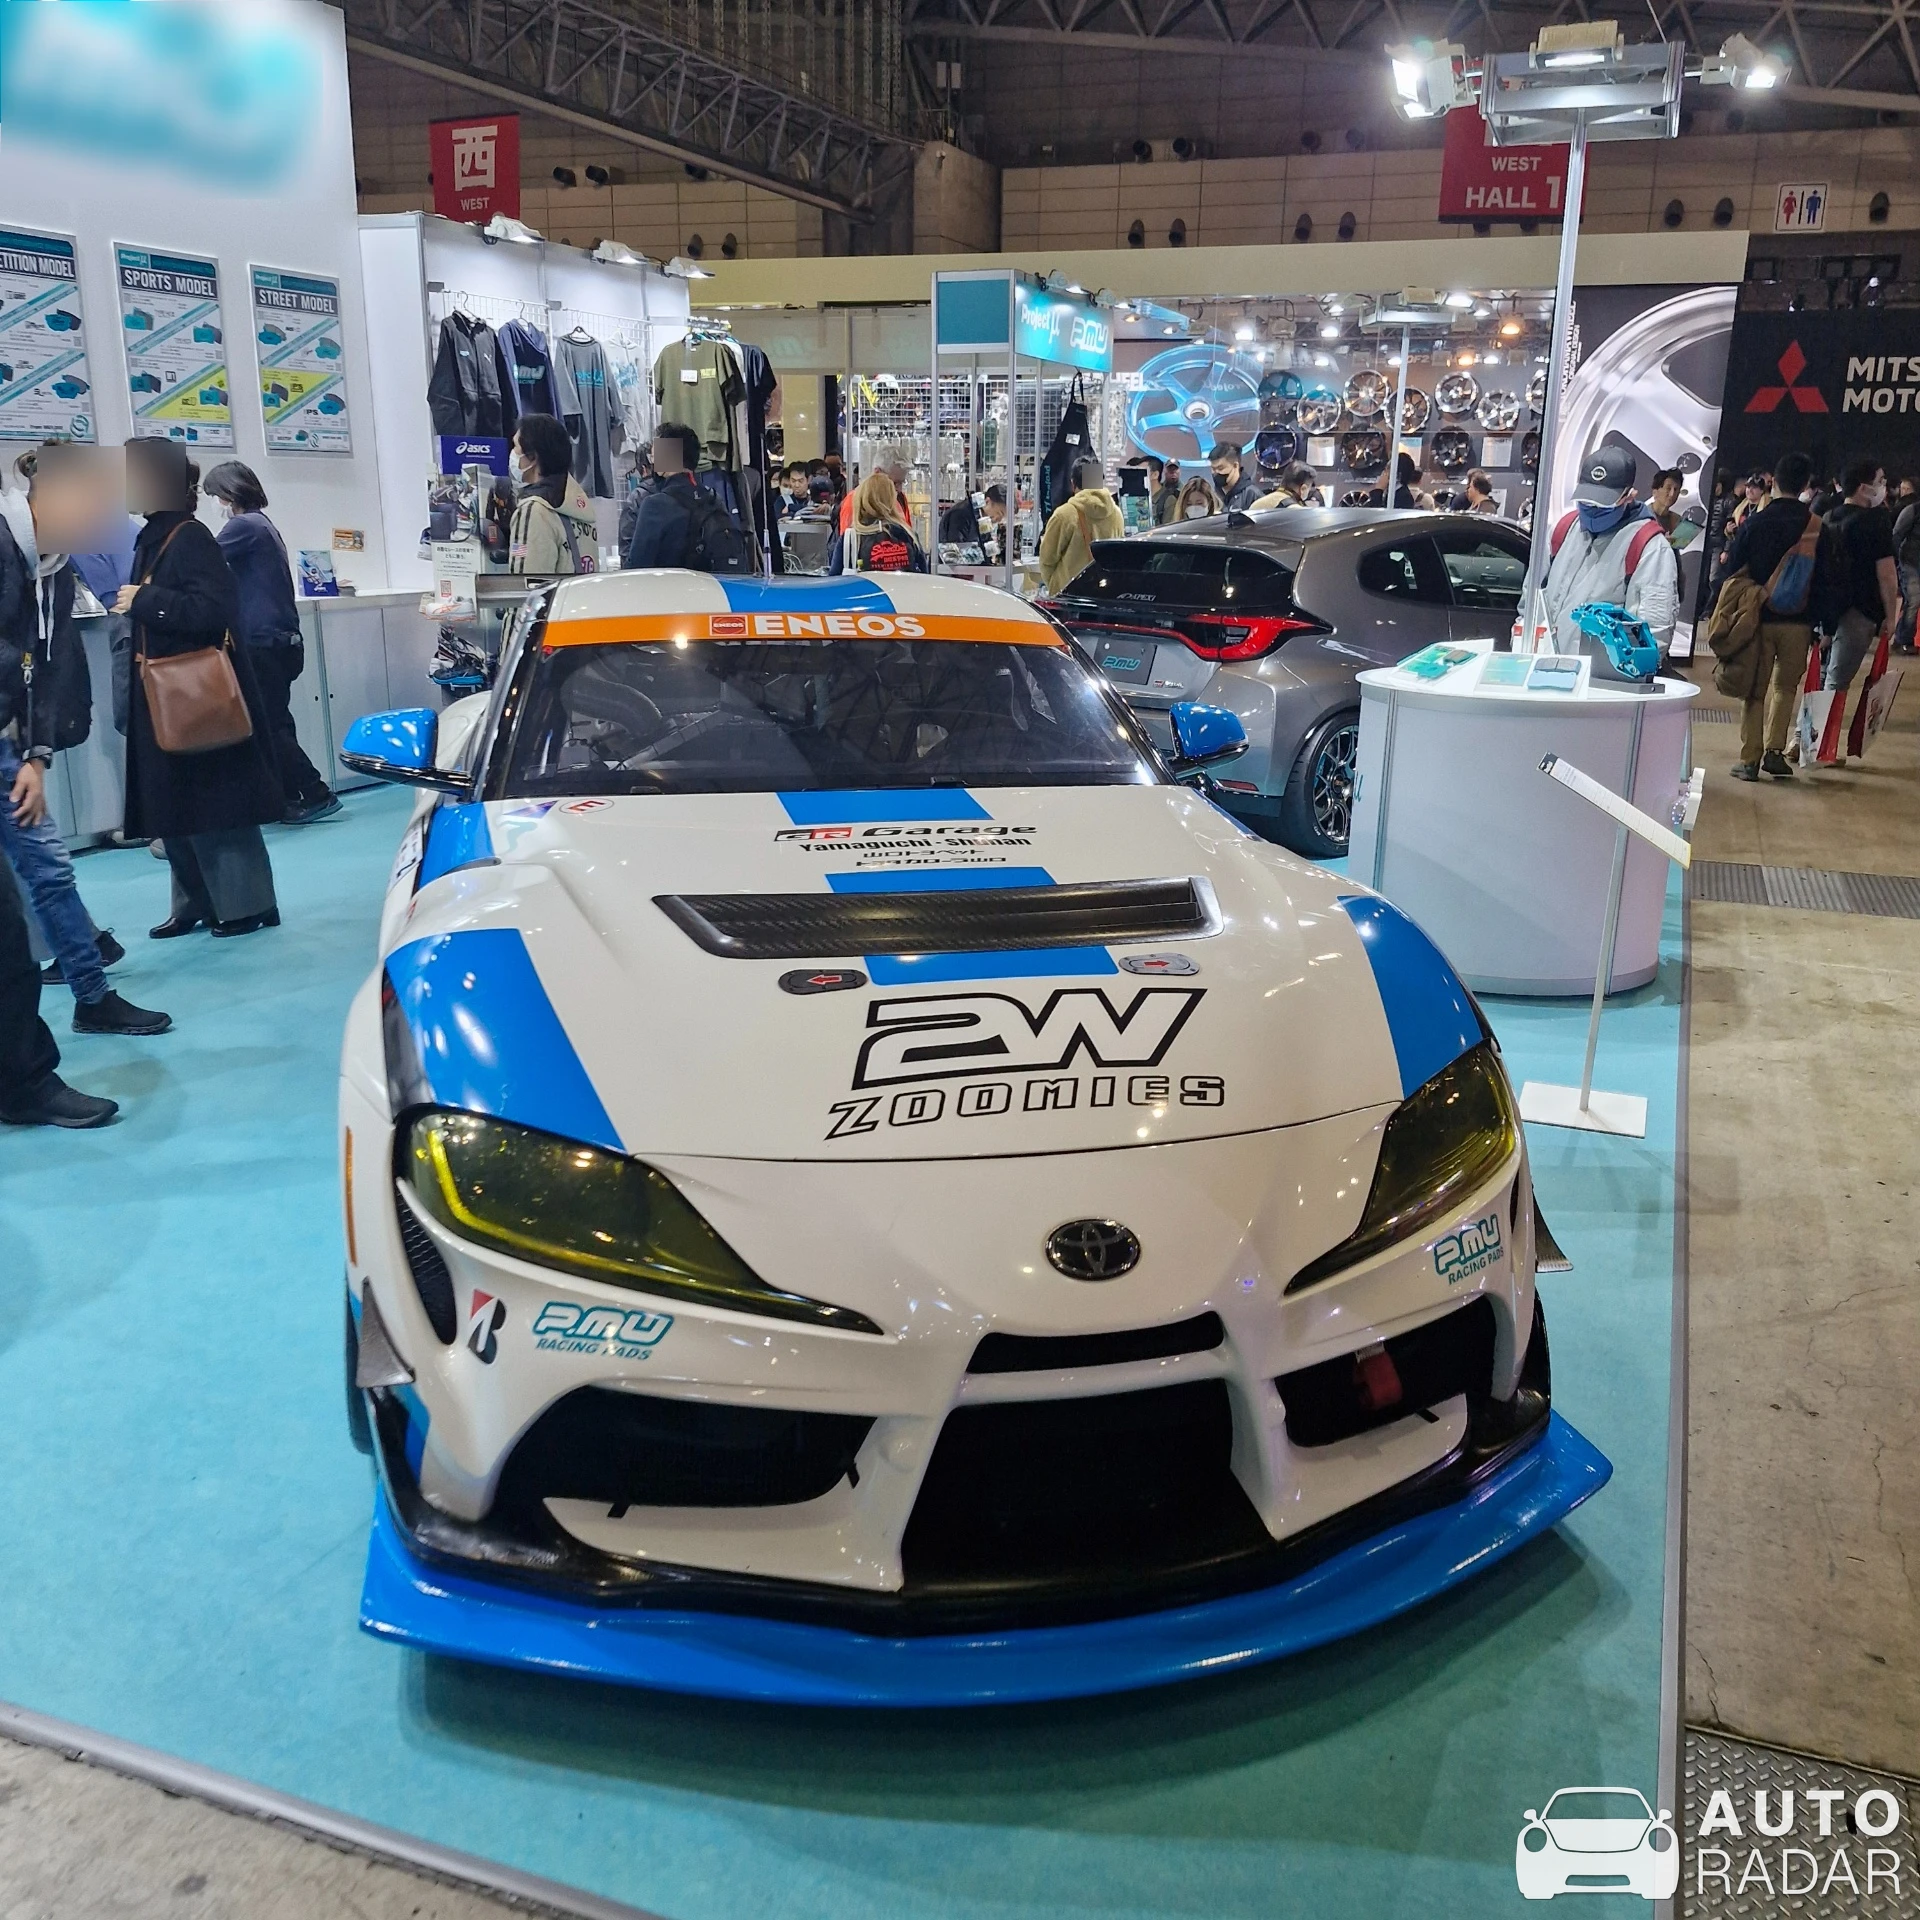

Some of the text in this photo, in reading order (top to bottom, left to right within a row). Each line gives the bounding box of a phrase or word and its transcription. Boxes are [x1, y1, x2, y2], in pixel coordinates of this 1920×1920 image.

[452, 125, 498, 191] 西
[1491, 156, 1542, 171] WEST
[1465, 175, 1561, 209] HALL 1
[460, 197, 490, 211] WEST
[39, 257, 75, 277] MODEL
[124, 269, 215, 296] SPORTS MODEL
[259, 289, 335, 313] STREET MODEL
[1021, 303, 1050, 331] Project
[1842, 387, 1920, 413] MOT
[713, 615, 926, 637] ENEOS ENEOS
[774, 826, 1038, 842] GR Garage
[799, 838, 930, 852] Yamaguchi
[947, 836, 1032, 847] Shunan
[863, 850, 985, 858] 山口トヨペット
[823, 1076, 1226, 1141] ZOOMIES
[1448, 1246, 1504, 1285] RACING PADS
[536, 1338, 600, 1354] RACING
